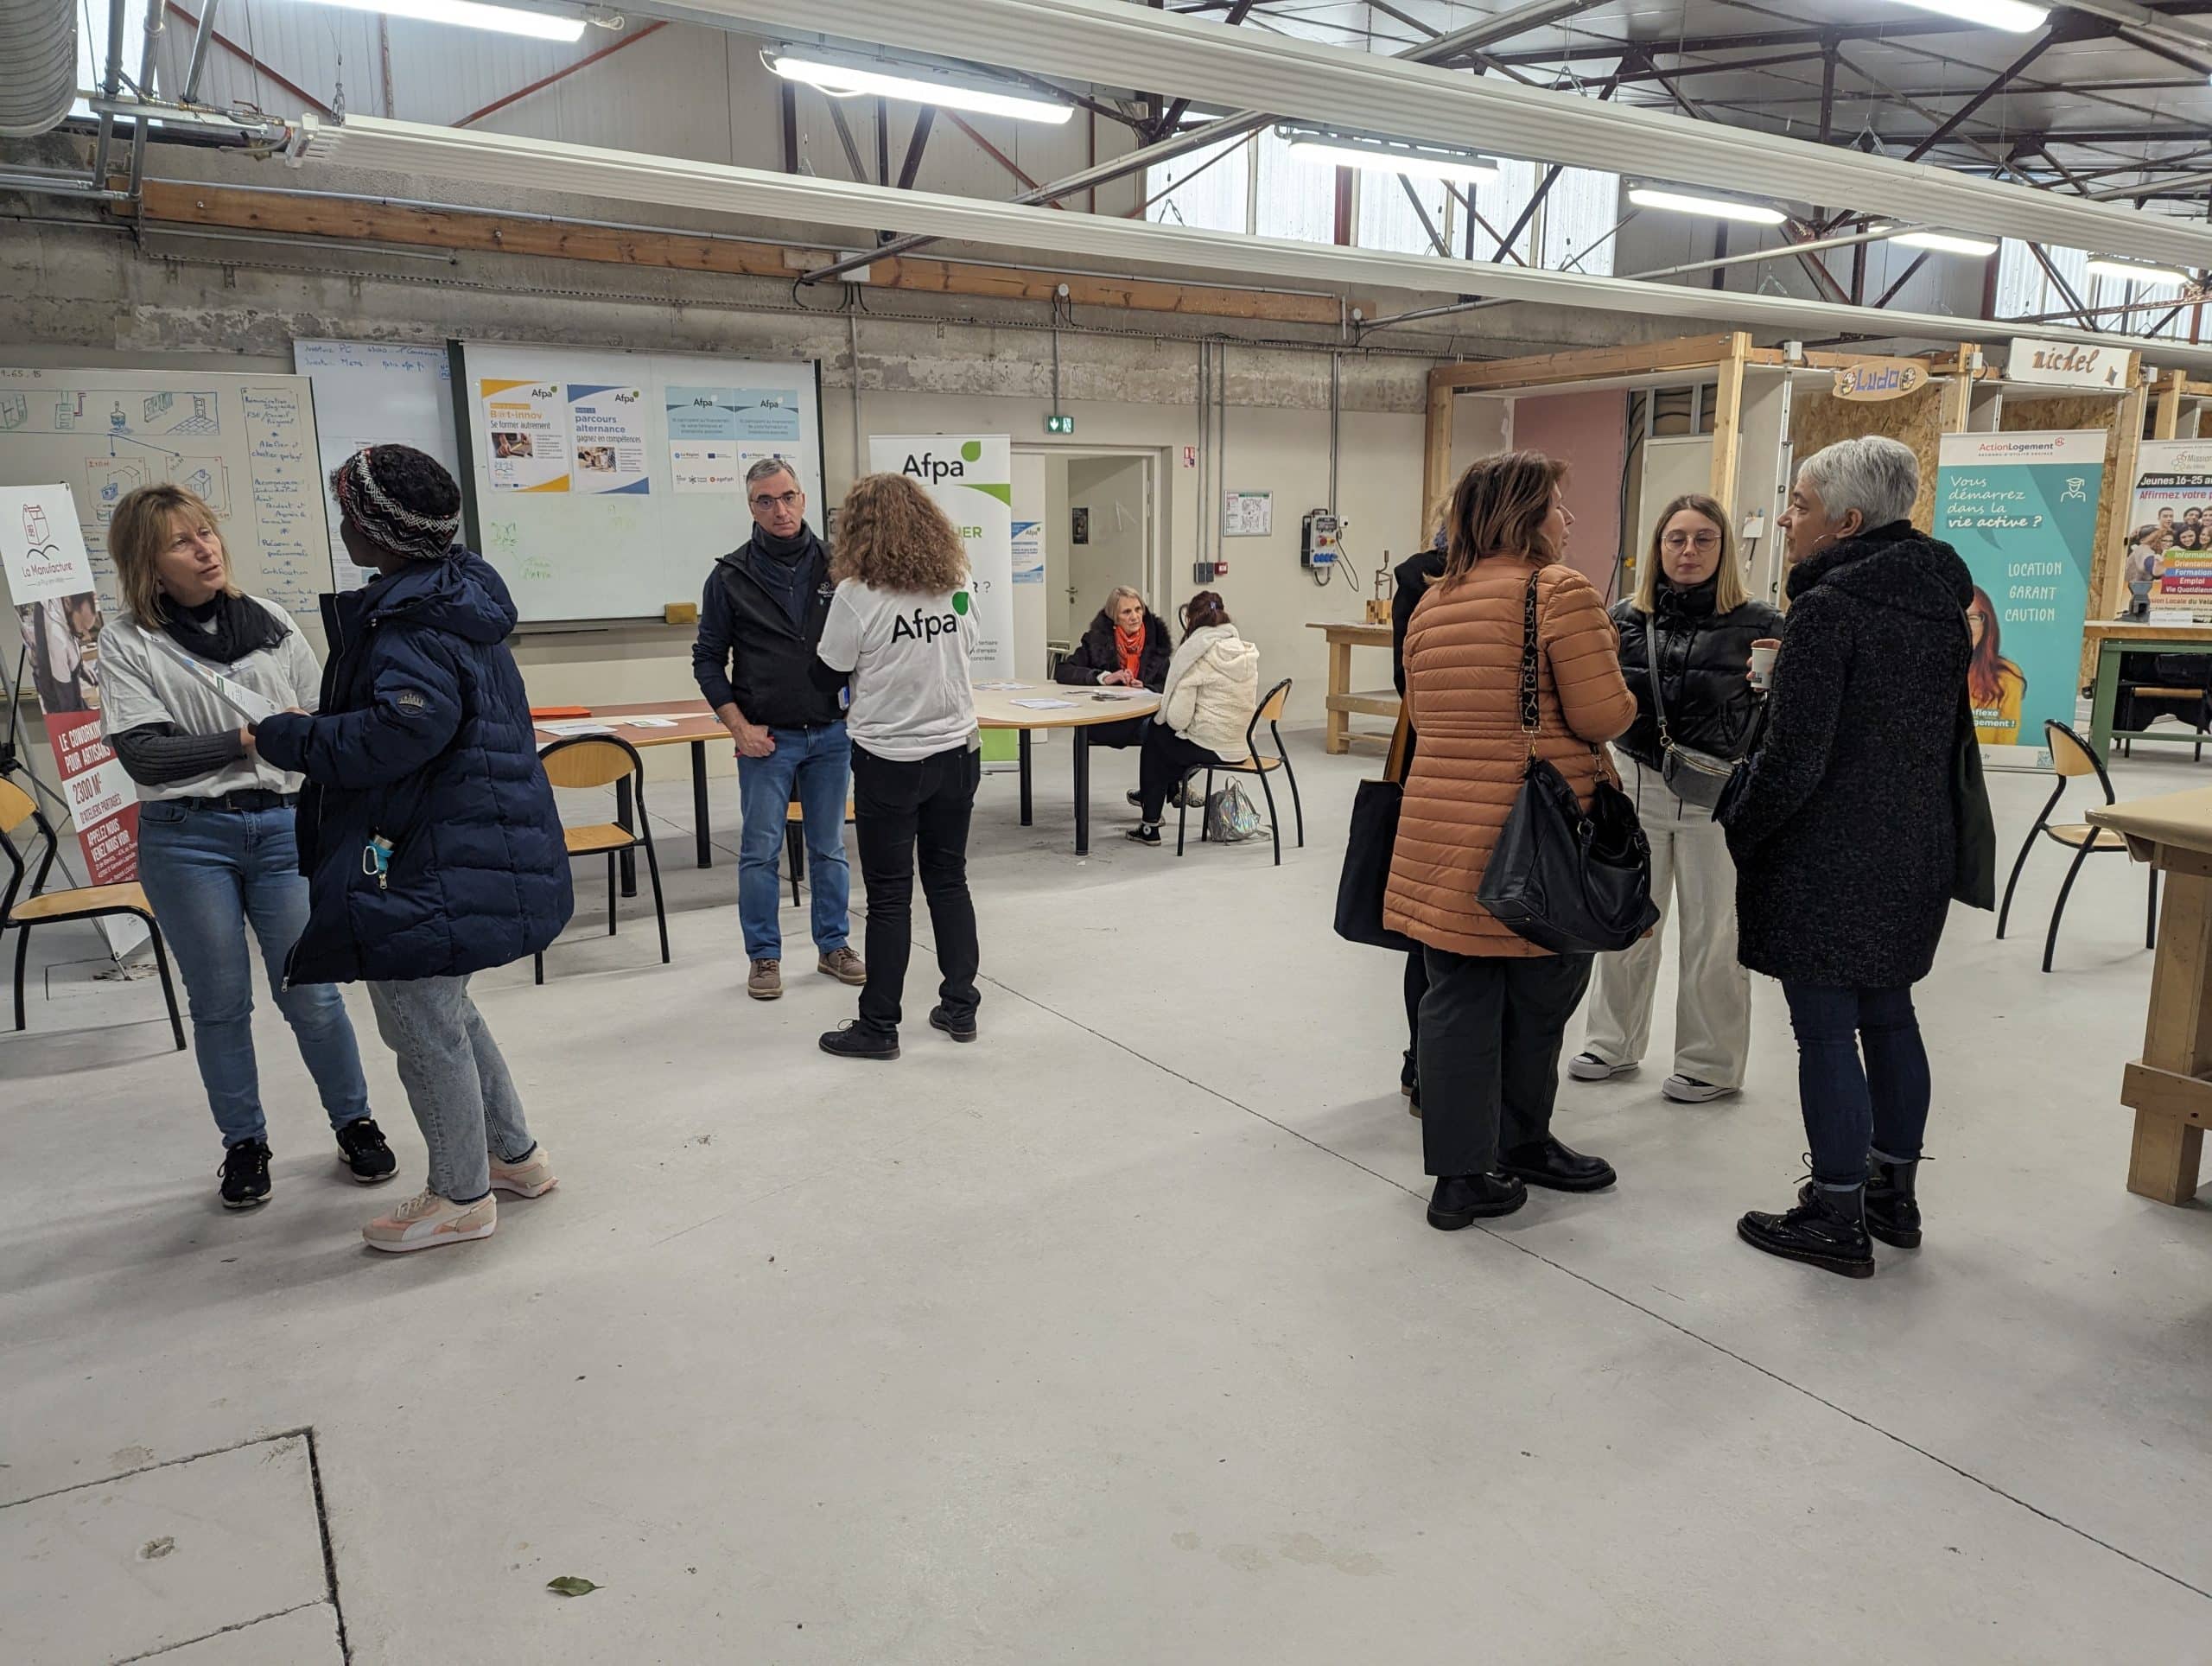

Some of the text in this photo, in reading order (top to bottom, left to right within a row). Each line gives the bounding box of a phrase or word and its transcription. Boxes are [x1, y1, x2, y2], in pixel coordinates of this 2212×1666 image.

[531, 389, 553, 400] Afpa
[615, 394, 635, 404] Afpa
[694, 397, 713, 408] Afpa
[760, 399, 779, 410] Afpa
[491, 420, 499, 429] Se
[575, 415, 617, 423] parcours
[575, 424, 626, 433] alternance
[576, 435, 597, 443] gagnez
[1979, 442, 2054, 452] ActionLogement
[902, 453, 964, 485] Afpa
[1950, 475, 1987, 486] Vous
[2141, 477, 2175, 486] Jeunes
[1948, 487, 2025, 500] démarrez
[2139, 490, 2180, 499] Affirmez
[1947, 502, 2006, 514] dans la
[1948, 515, 2043, 528] vie active ?
[22, 562, 73, 578] La Manufacture
[2008, 562, 2063, 577] LOCATION
[2009, 586, 2056, 601] GARANT
[2005, 608, 2055, 622] CAUTION
[891, 608, 957, 644] Afpa
[59, 733, 69, 752] LE
[65, 752, 82, 773] POUR
[73, 778, 93, 805] 2300
